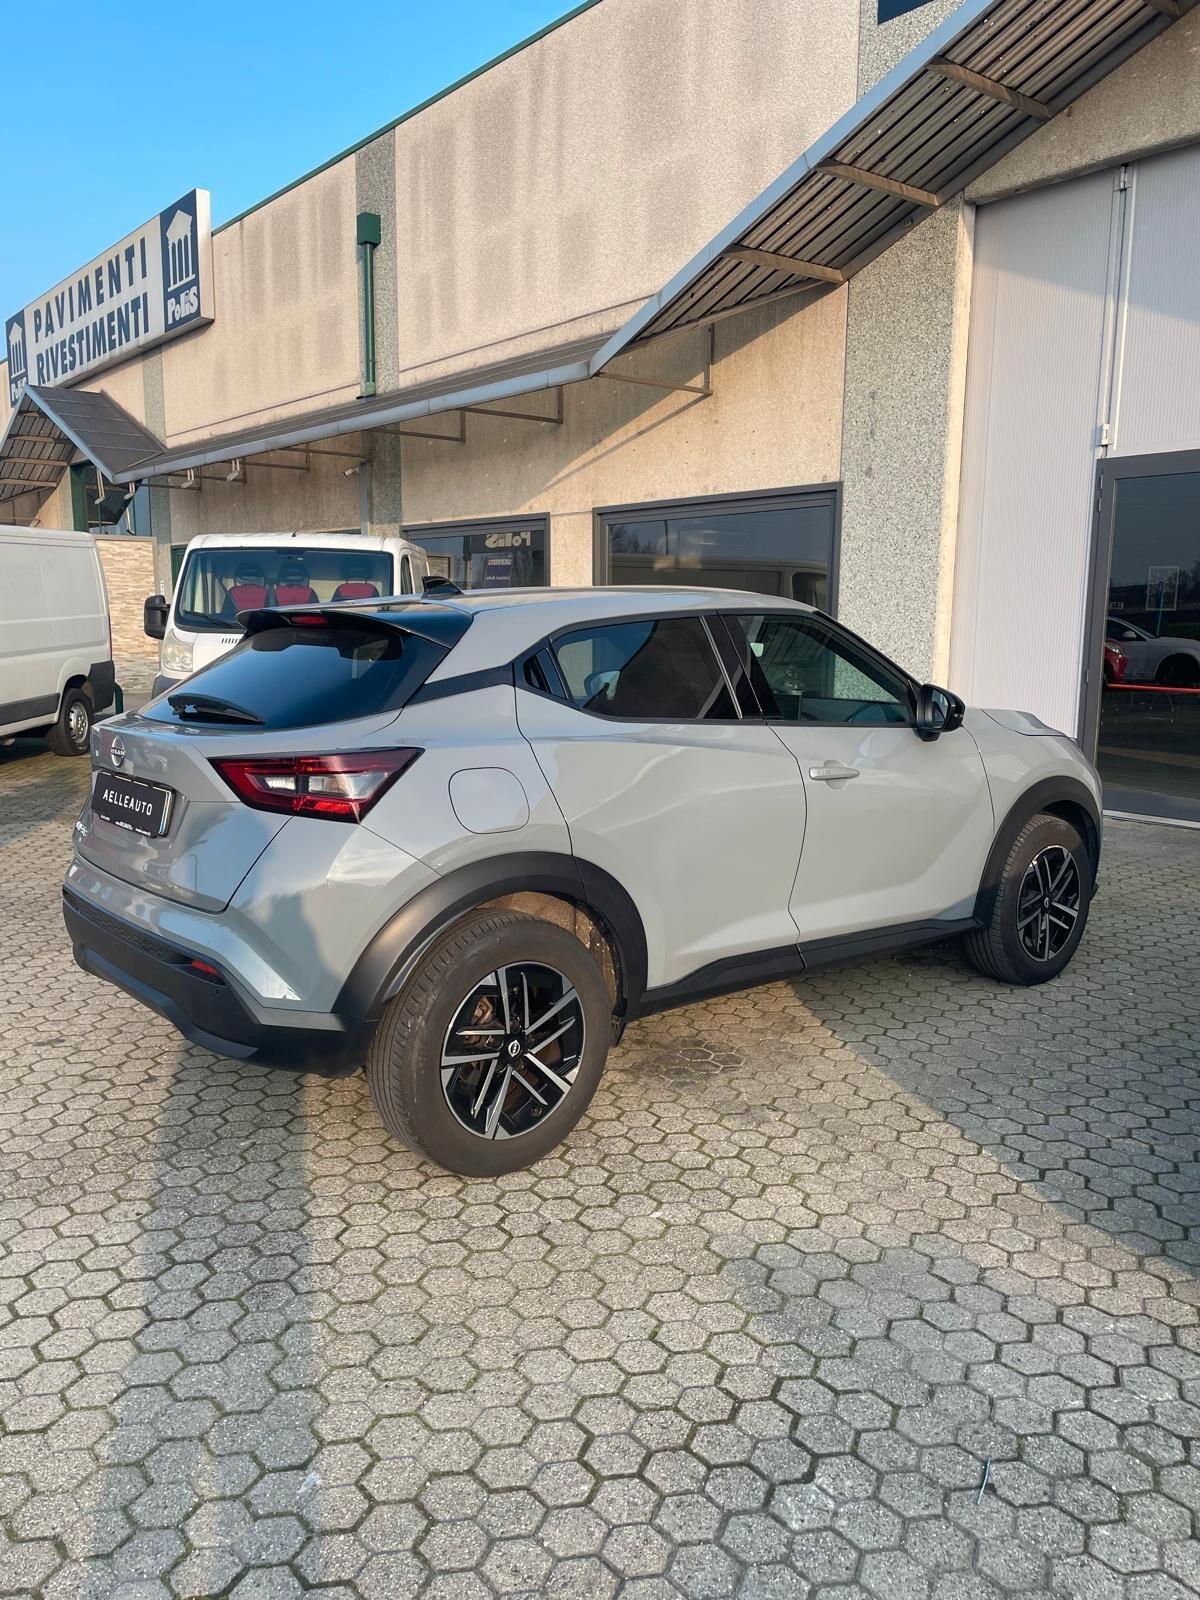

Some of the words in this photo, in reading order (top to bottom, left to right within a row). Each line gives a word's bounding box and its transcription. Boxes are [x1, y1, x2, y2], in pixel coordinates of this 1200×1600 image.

[33, 237, 147, 343] PAVIMENTI
[36, 292, 149, 387] RIVESTIMENTI
[102, 788, 153, 816] AELLEAUTO
